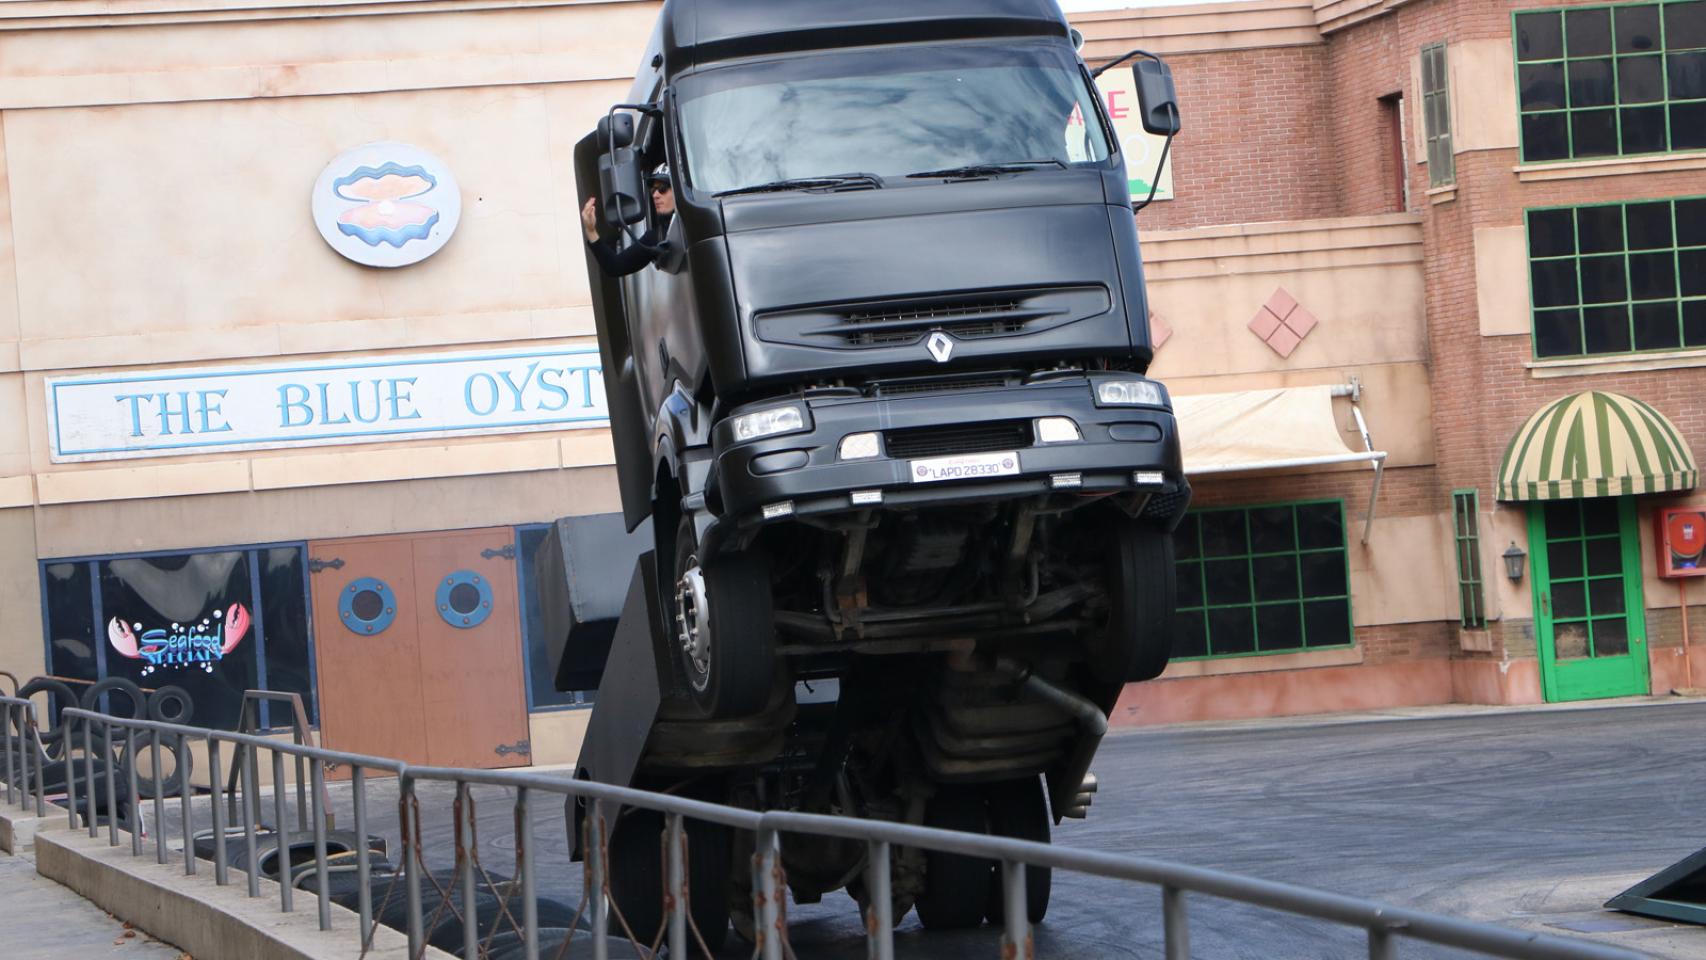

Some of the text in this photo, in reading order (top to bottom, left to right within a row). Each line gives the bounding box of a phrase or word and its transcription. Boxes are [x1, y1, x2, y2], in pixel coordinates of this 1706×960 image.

[114, 361, 602, 437] THE BLUE OYST
[139, 623, 222, 656] Seafood
